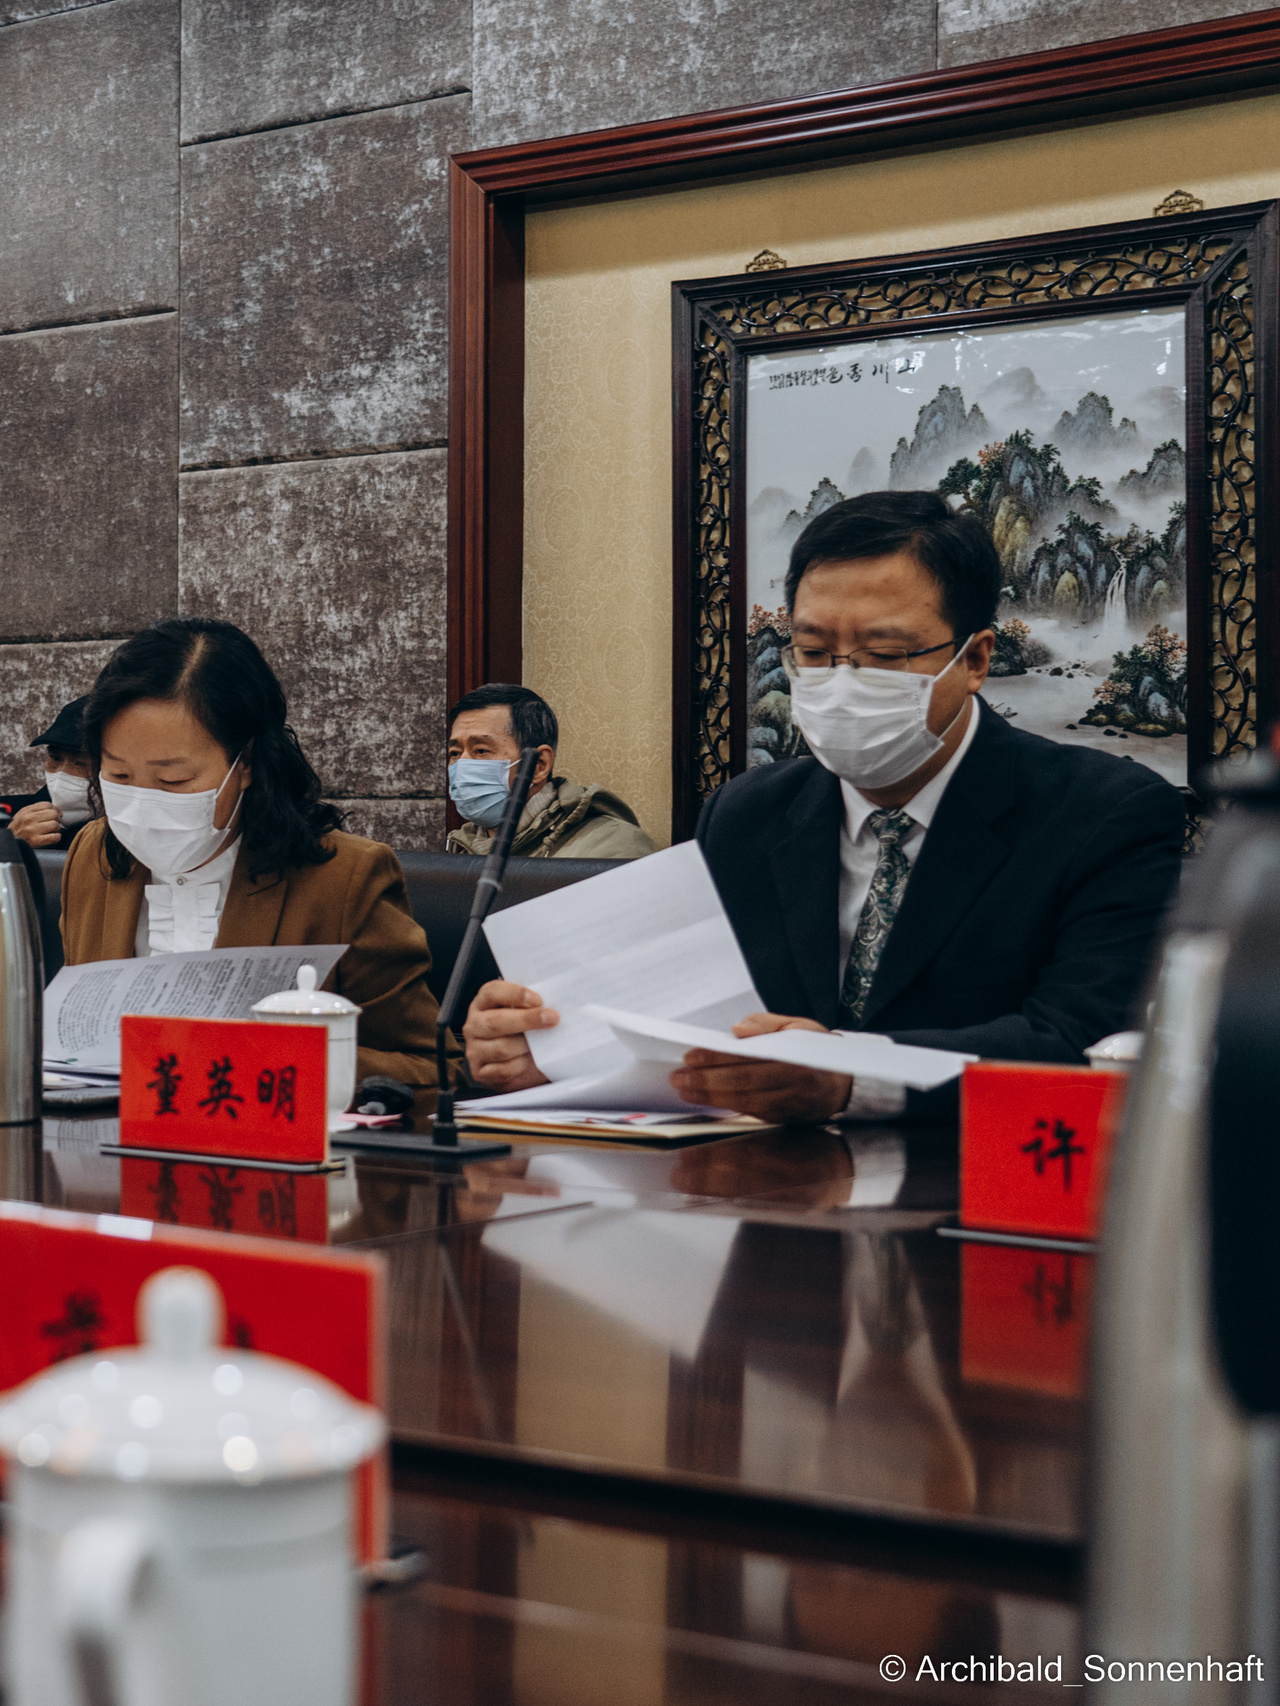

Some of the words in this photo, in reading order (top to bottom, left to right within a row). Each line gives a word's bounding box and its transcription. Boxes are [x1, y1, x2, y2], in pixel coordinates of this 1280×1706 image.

[146, 1053, 297, 1123] 董英明
[1020, 1118, 1086, 1194] 许
